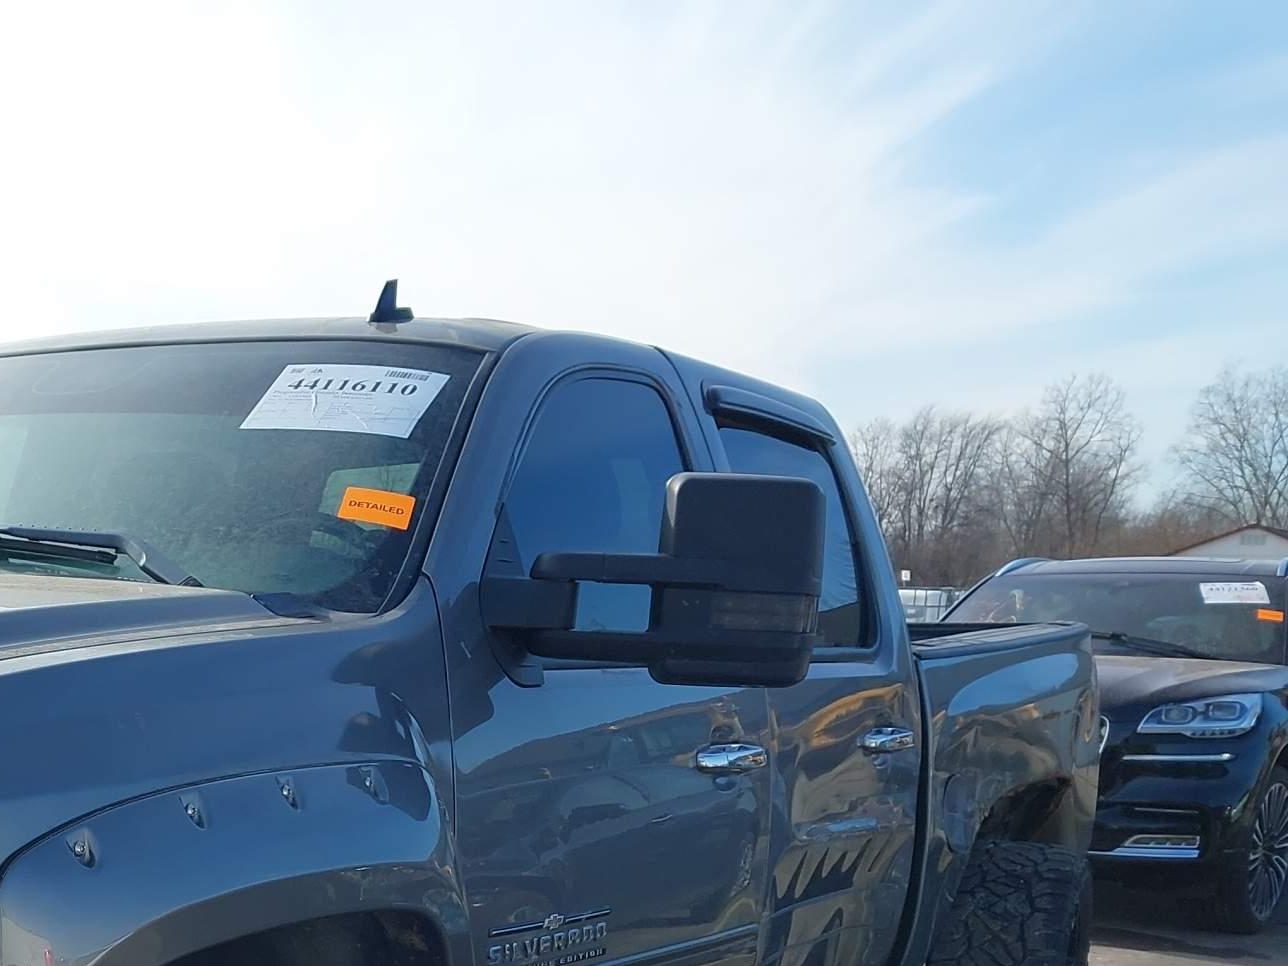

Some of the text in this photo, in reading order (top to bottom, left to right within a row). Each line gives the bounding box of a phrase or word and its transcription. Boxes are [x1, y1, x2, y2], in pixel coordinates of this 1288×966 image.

[287, 376, 418, 397] 44116110
[347, 499, 405, 516] DETAILED
[487, 921, 609, 965] SILVERADO
[559, 948, 604, 965] EDITION
